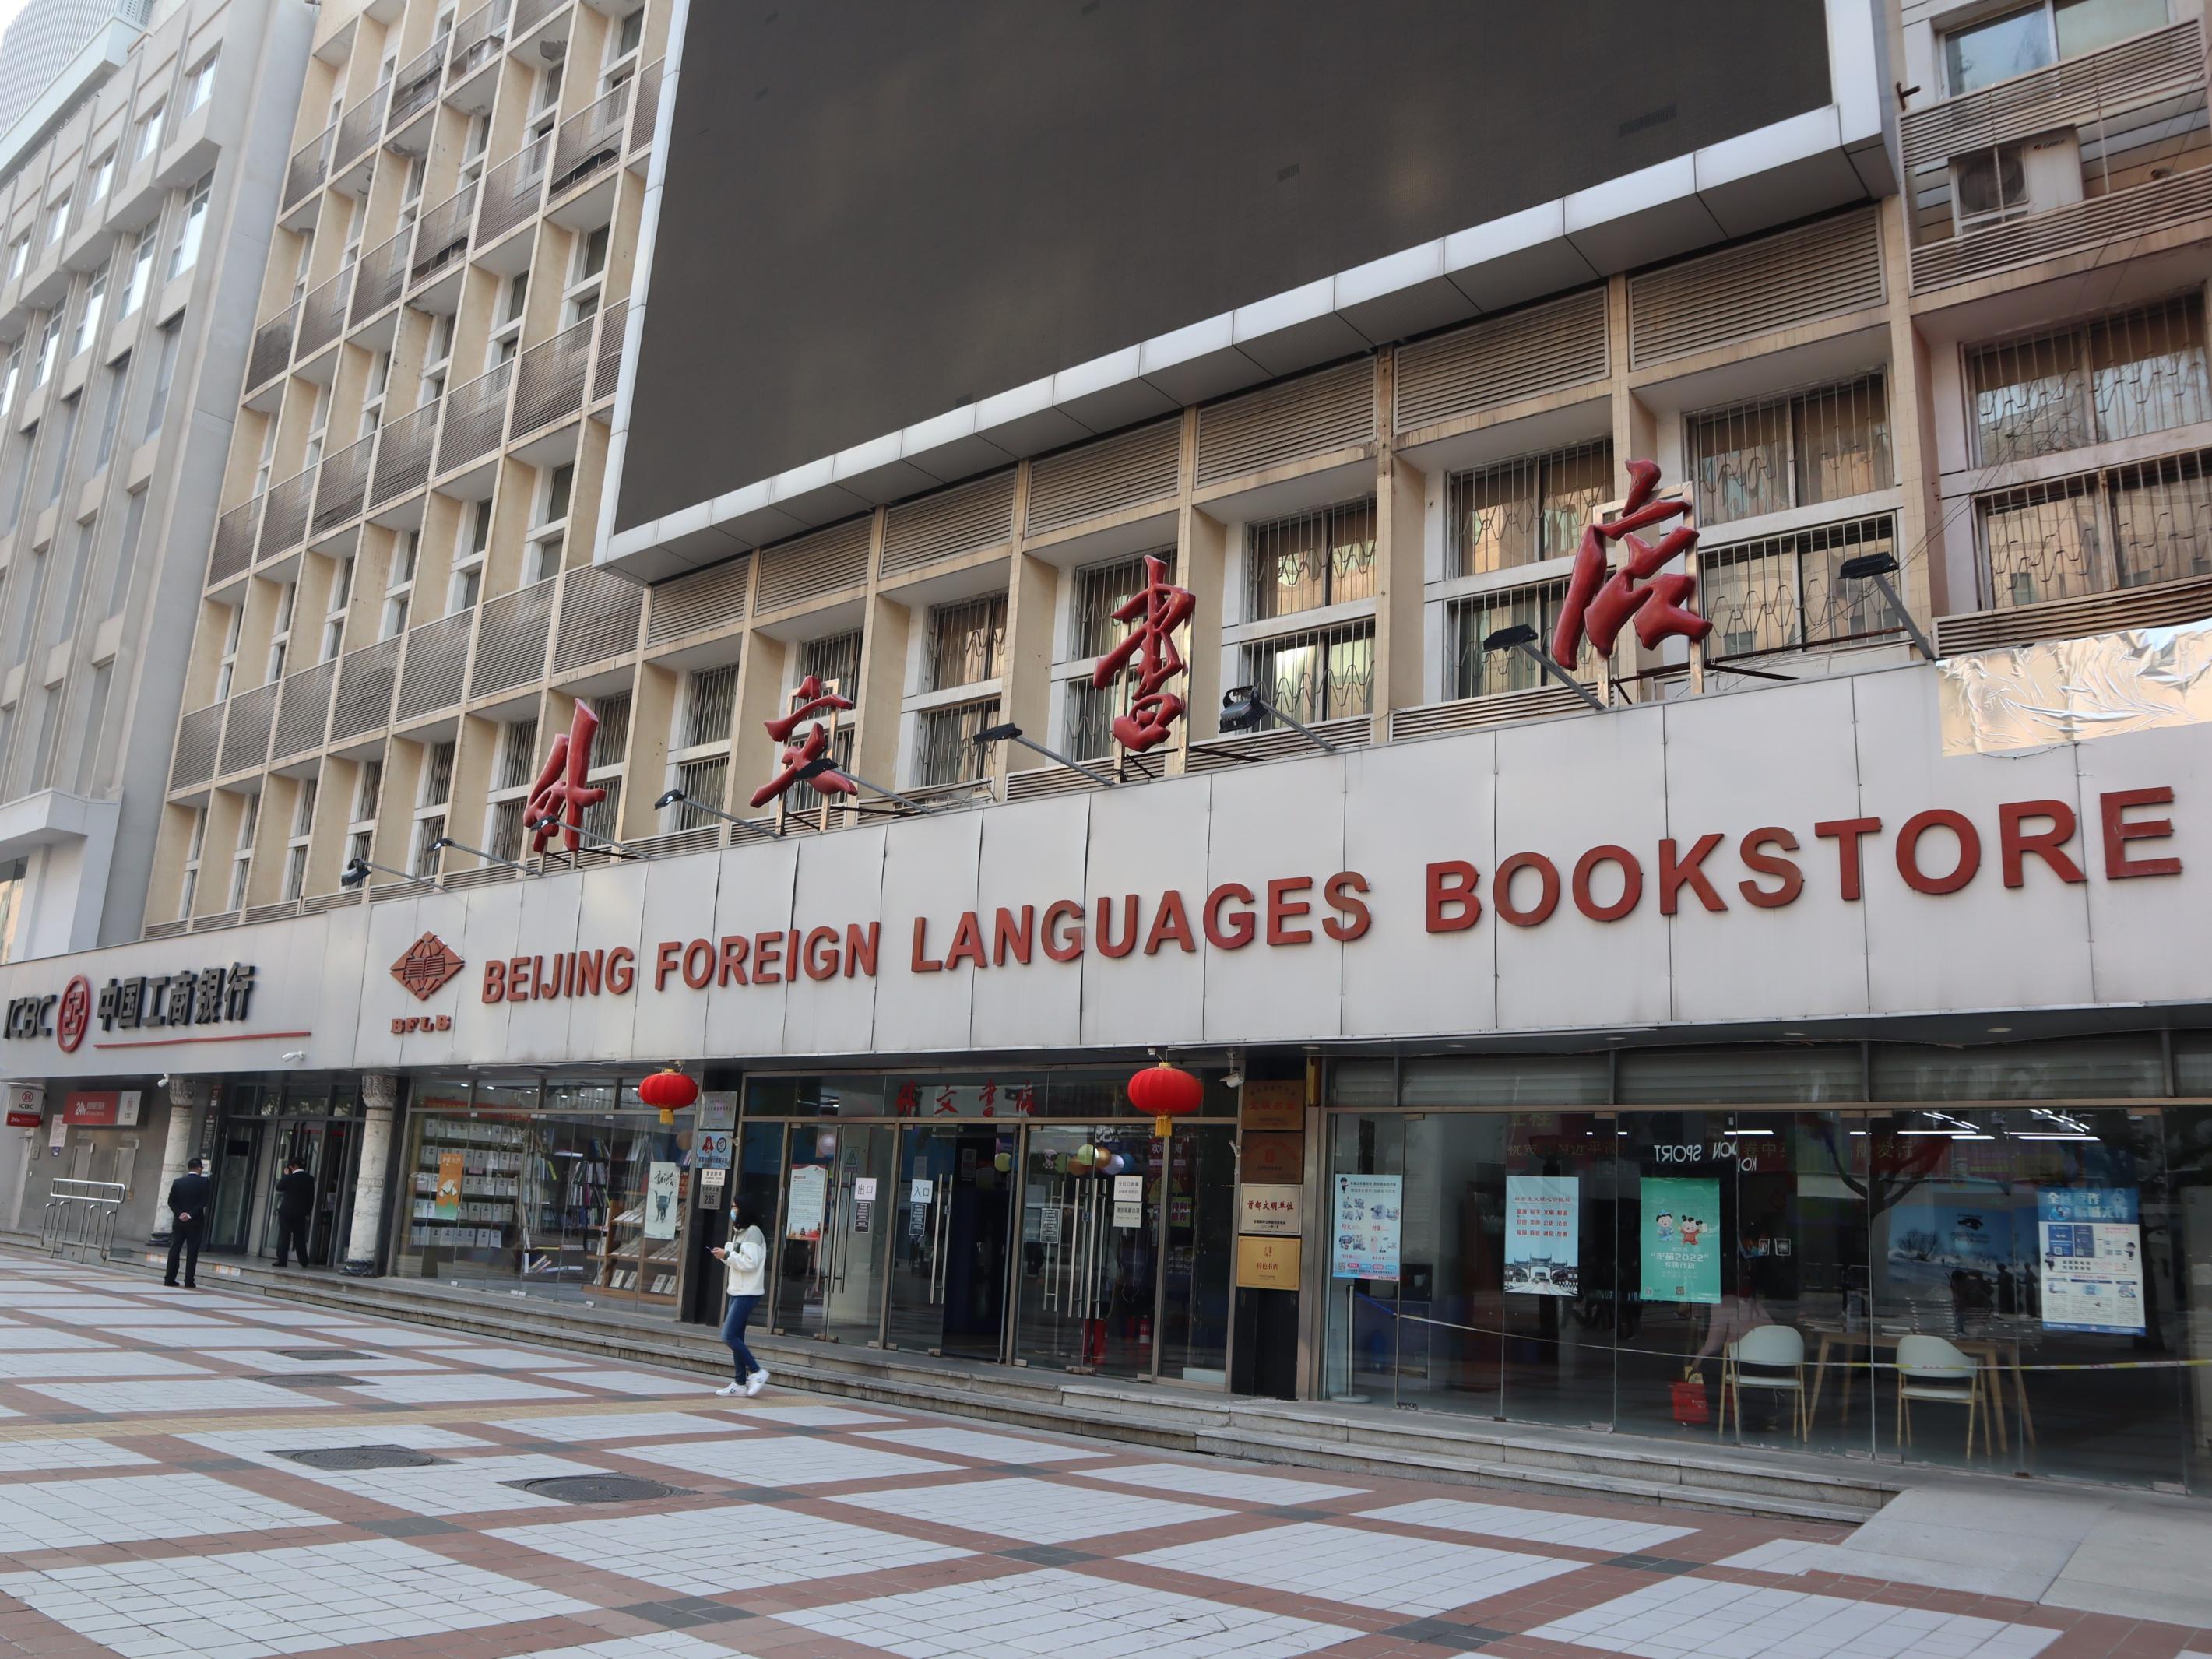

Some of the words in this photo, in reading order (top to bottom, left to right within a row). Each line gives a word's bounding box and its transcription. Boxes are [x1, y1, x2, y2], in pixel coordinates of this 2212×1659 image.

[481, 946, 635, 1003] BEIJING
[653, 921, 880, 991] FOREIGN
[910, 870, 1370, 973] LANGUAGES
[1425, 786, 2182, 933] BOOKSTORE
[97, 961, 255, 1032] 中国工商银行
[2, 994, 57, 1039] ICBC
[391, 1015, 452, 1034] BFLB
[858, 1184, 873, 1195] 出口
[913, 1186, 930, 1197] 入口
[704, 1195, 715, 1205] 235
[1247, 1200, 1294, 1212] 首都文明单位
